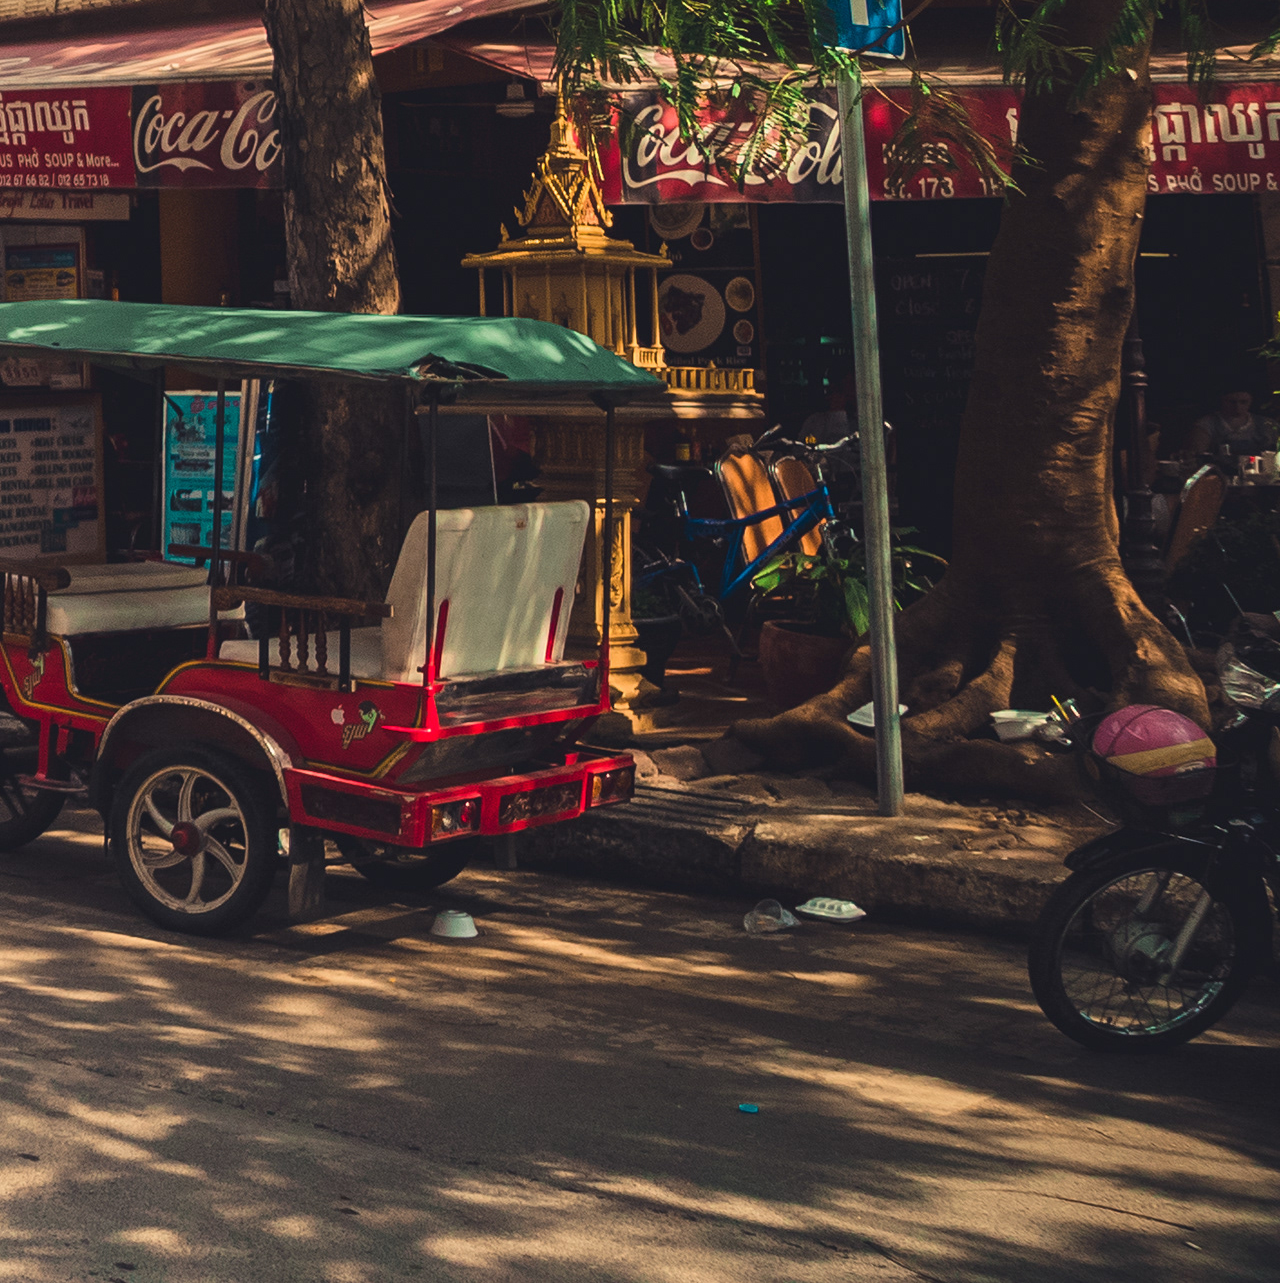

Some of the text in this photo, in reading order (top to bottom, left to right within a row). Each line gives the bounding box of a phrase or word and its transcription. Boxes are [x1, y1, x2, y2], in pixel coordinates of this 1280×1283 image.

[133, 90, 281, 173] Coca-Co
[44, 152, 74, 168] SOUP
[76, 153, 84, 168] &
[13, 174, 24, 186] 67
[25, 174, 36, 186] 66
[57, 174, 70, 186] 012
[86, 174, 98, 186] 73
[1212, 173, 1260, 192] SOUP
[1266, 172, 1278, 191] &
[61, 192, 94, 209] Travel
